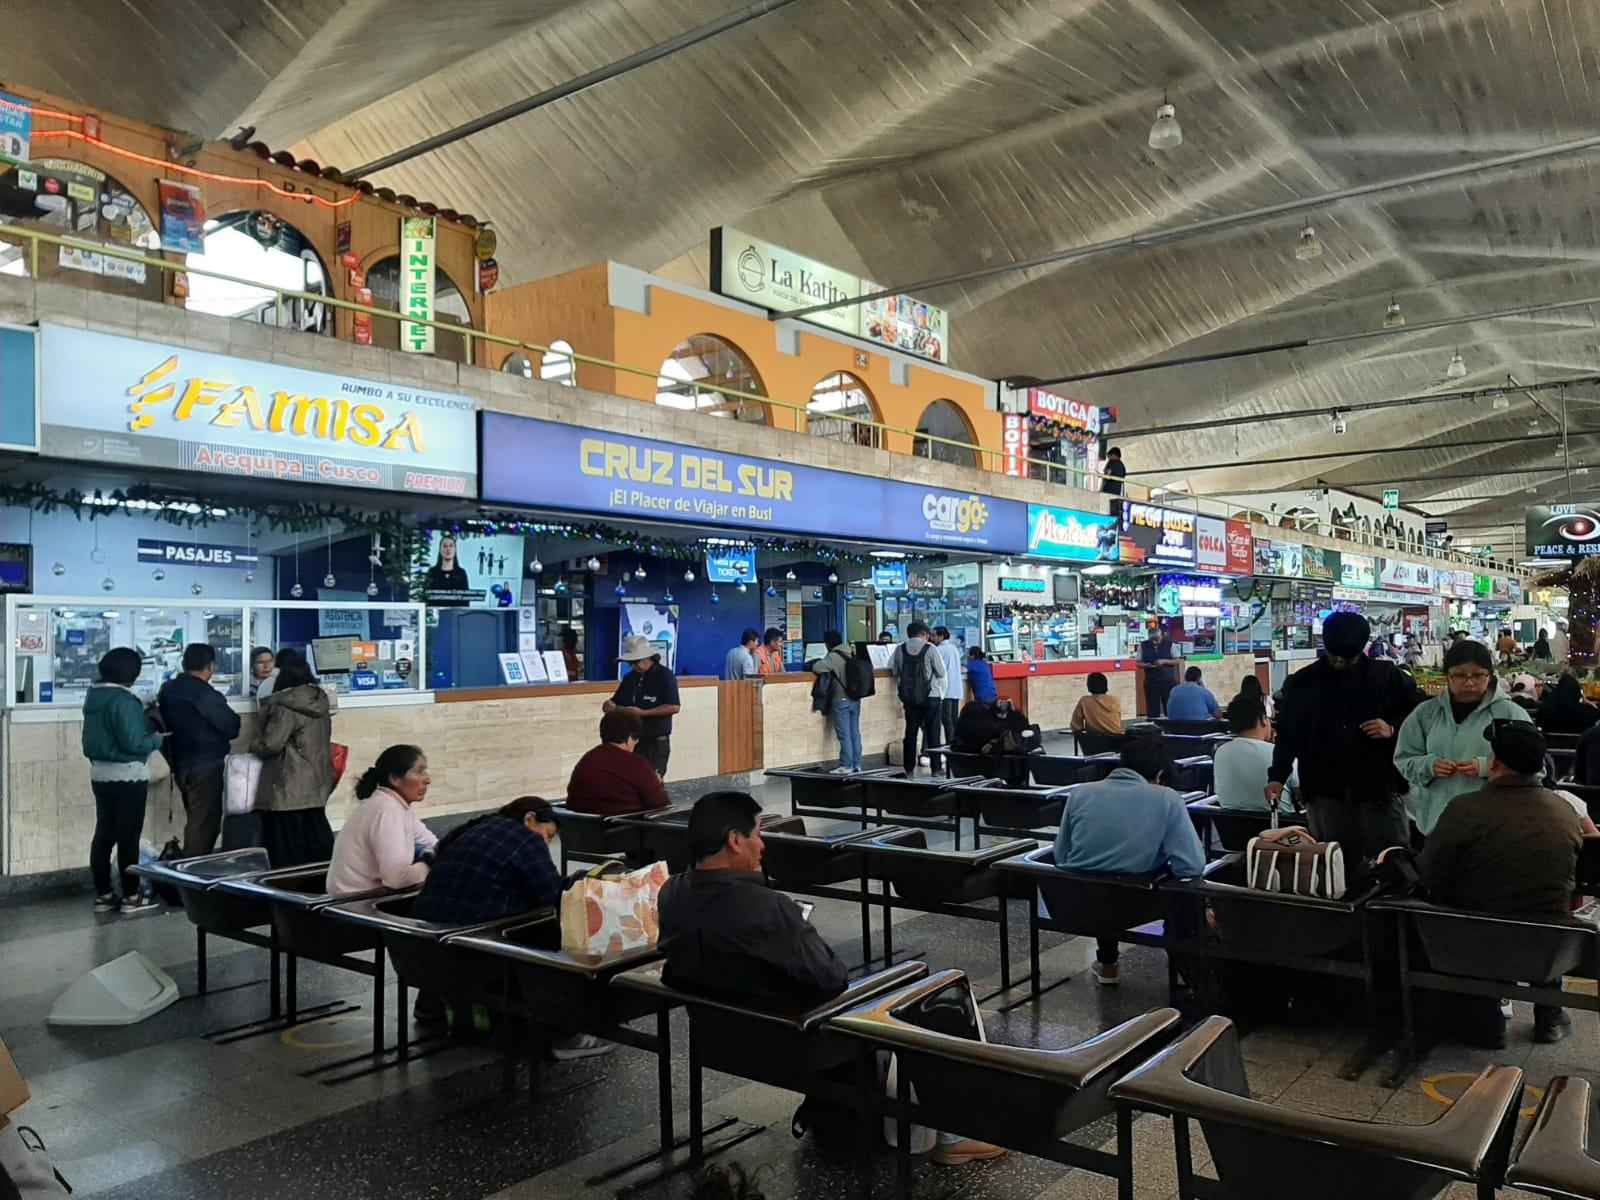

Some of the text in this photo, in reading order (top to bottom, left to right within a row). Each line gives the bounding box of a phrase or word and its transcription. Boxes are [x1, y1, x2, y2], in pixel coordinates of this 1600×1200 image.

[409, 240, 428, 350] INTERNET
[770, 258, 849, 308] La Katita
[341, 383, 475, 411] RUMBO A SU EXCELENCIA
[1037, 390, 1087, 420] BOTICA
[195, 445, 303, 477] Arequipa
[319, 458, 381, 483] Cusco
[580, 438, 794, 502] CRUZ DEL SUR
[609, 490, 628, 508] ¡El
[631, 494, 672, 511] Placer
[674, 496, 690, 512] de
[693, 498, 730, 519] Viajar
[731, 505, 746, 518] en
[922, 494, 984, 533] cargo
[1130, 504, 1194, 533] MEGA BUSES
[1550, 504, 1576, 514] LOVE
[166, 545, 233, 564] PASAJES
[1199, 536, 1224, 552] COLCA
[1534, 545, 1564, 555] PEACE
[1566, 545, 1576, 553] &
[356, 677, 376, 686] VISA
